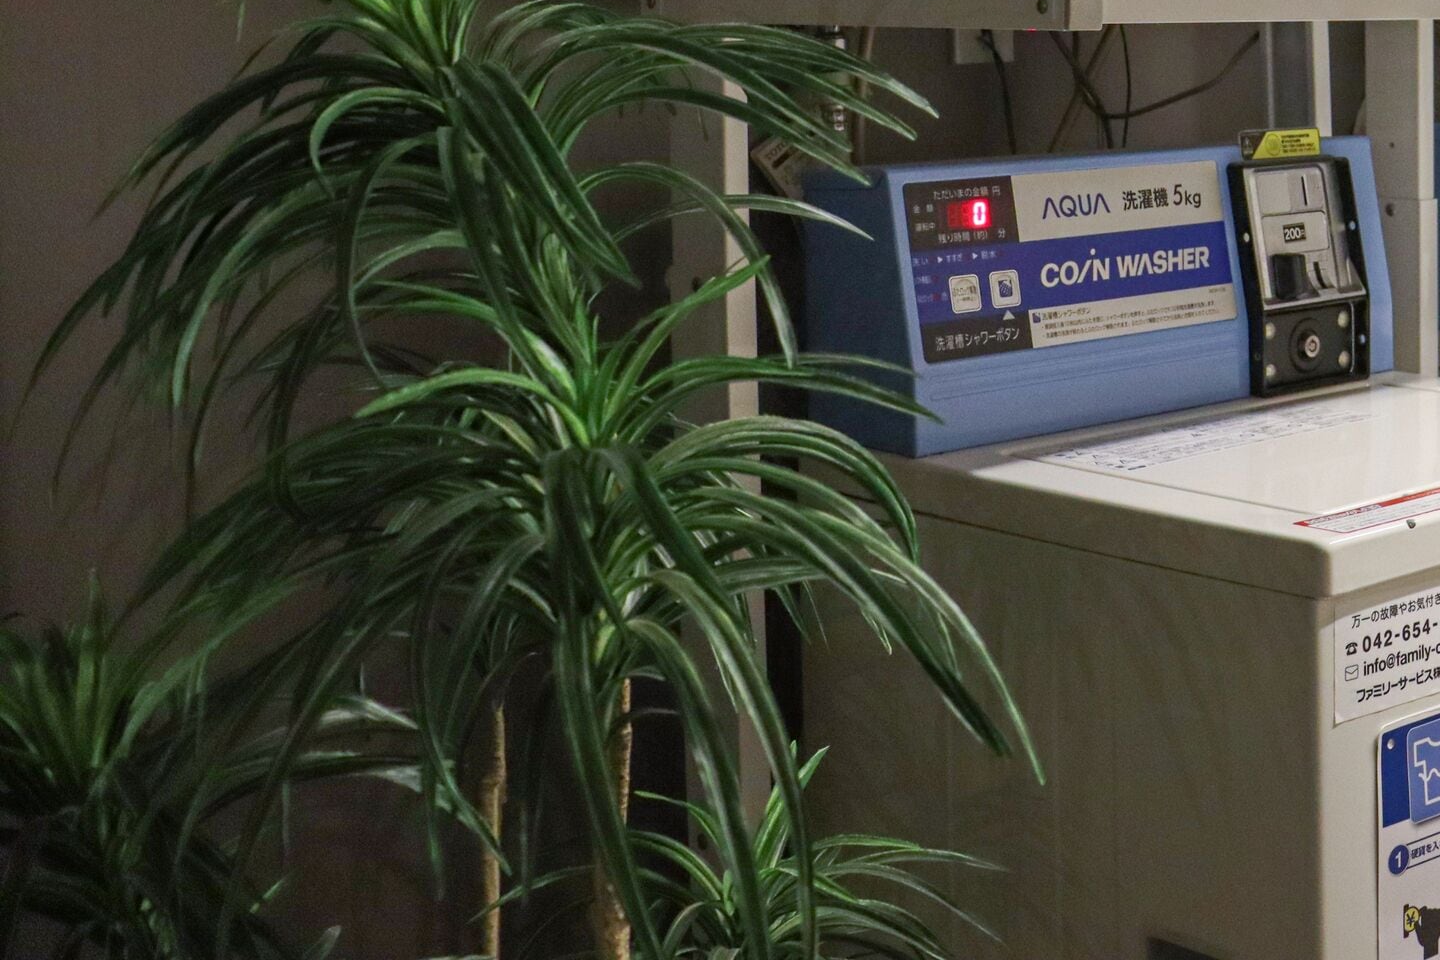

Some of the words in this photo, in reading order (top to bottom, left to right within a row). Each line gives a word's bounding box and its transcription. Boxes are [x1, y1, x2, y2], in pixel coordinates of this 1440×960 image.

[991, 185, 1001, 196] 円
[1122, 187, 1169, 212] 洗濯機
[1173, 184, 1202, 209] 5kg
[972, 201, 987, 226] 0
[1042, 193, 1111, 220] AQUA
[1116, 246, 1211, 279] WASHER
[935, 327, 1020, 352] 洗濯槽シャワーボタン
[1394, 851, 1402, 868] 1
